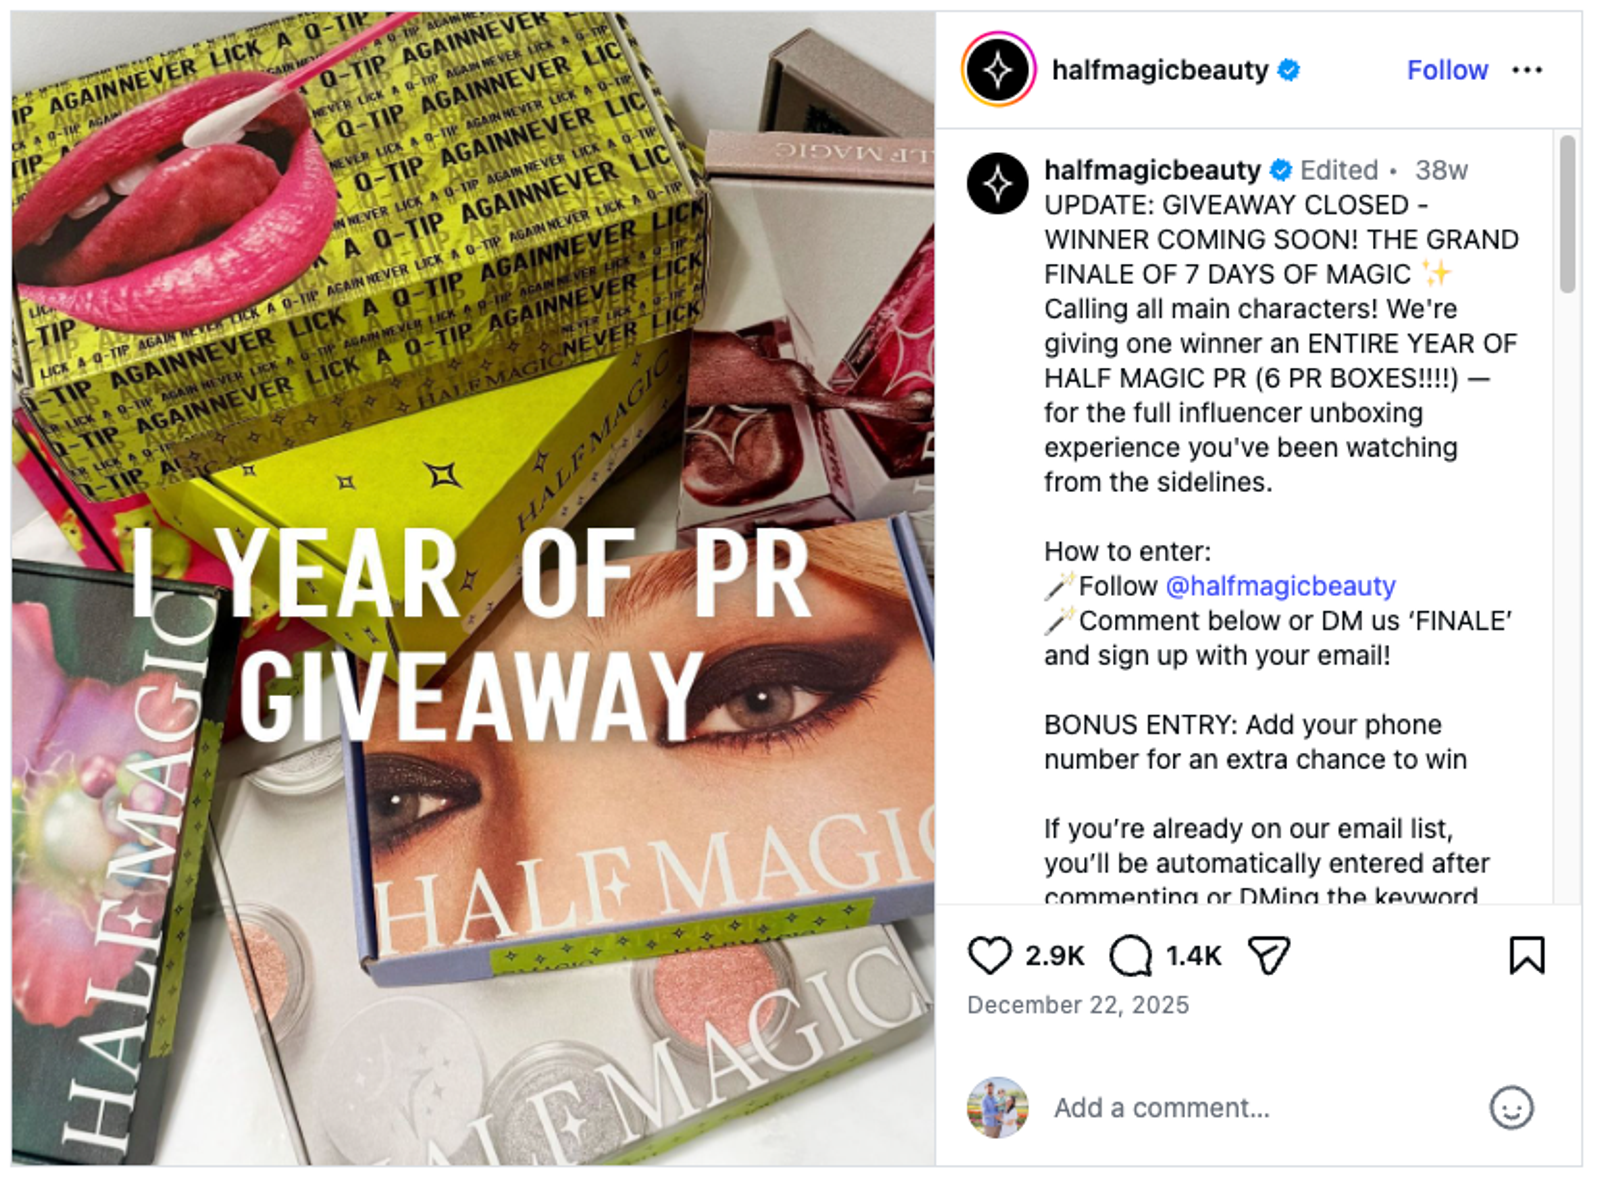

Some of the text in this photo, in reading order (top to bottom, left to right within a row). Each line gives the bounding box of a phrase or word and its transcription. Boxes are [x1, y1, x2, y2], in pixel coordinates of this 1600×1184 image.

[209, 39, 262, 68] LICK
[277, 32, 292, 49] A
[1052, 57, 1270, 86] halfmagicbeauty
[1408, 58, 1490, 81] Follow
[1045, 157, 1469, 186] halfmagicbeauty Edited 38w
[652, 198, 706, 232] LICK
[1045, 193, 1409, 216] UPDATE: GIVEAWAY CLOSED
[344, 237, 361, 259] A
[414, 255, 444, 270] LICK
[595, 200, 626, 216] LICK
[1044, 228, 1520, 251] WINNER COMING SOON! THE GRAND
[652, 251, 707, 283] LICK
[1045, 263, 1411, 285] FINALE OF 7 DAYS OF MAGIC
[288, 307, 346, 338] LICK
[363, 298, 379, 317] A
[1044, 297, 1128, 325] Calling
[1136, 297, 1163, 320] all
[1171, 296, 1230, 320] main
[1237, 297, 1378, 320] characters!
[1044, 331, 1519, 360] giving one winner an ENTIRE YEAR OF
[305, 356, 360, 386] LICK
[1045, 366, 1459, 393] HALF MAGIC PR (6 PR BOXES!!!!)
[1043, 400, 1423, 429] for the full influencer unboxing
[1044, 435, 1181, 463] experience
[1277, 435, 1338, 458] been
[1345, 435, 1458, 463] watching
[1043, 470, 1273, 493] from the sidelines.
[1045, 540, 1211, 562] How to enter:
[1079, 574, 1397, 602] Follow @halfmagicbeauty
[1079, 609, 1201, 632] Comment
[1208, 608, 1282, 632] below
[1288, 613, 1315, 632] or
[1322, 609, 1363, 631] DM
[1371, 613, 1400, 632] us
[1044, 643, 1390, 671] and sign up with your email!
[1045, 712, 1442, 741] BONUS ENTRY: Add your phone
[1045, 747, 1467, 770] number for an extra chance to win
[1045, 816, 1061, 839] If
[1152, 816, 1244, 845] already
[1251, 821, 1282, 840] on
[1289, 821, 1331, 840] our
[1337, 816, 1403, 840] email
[1411, 816, 1453, 844] list,
[1118, 851, 1149, 874] be
[1156, 851, 1322, 879] automatically
[1328, 851, 1424, 874] entered
[1431, 851, 1492, 874] after
[1326, 886, 1367, 903] the
[1025, 944, 1223, 967] 2.9K 1.4K
[968, 995, 1190, 1018] December 22, 2025
[1054, 1096, 1270, 1118] Add a comment...
